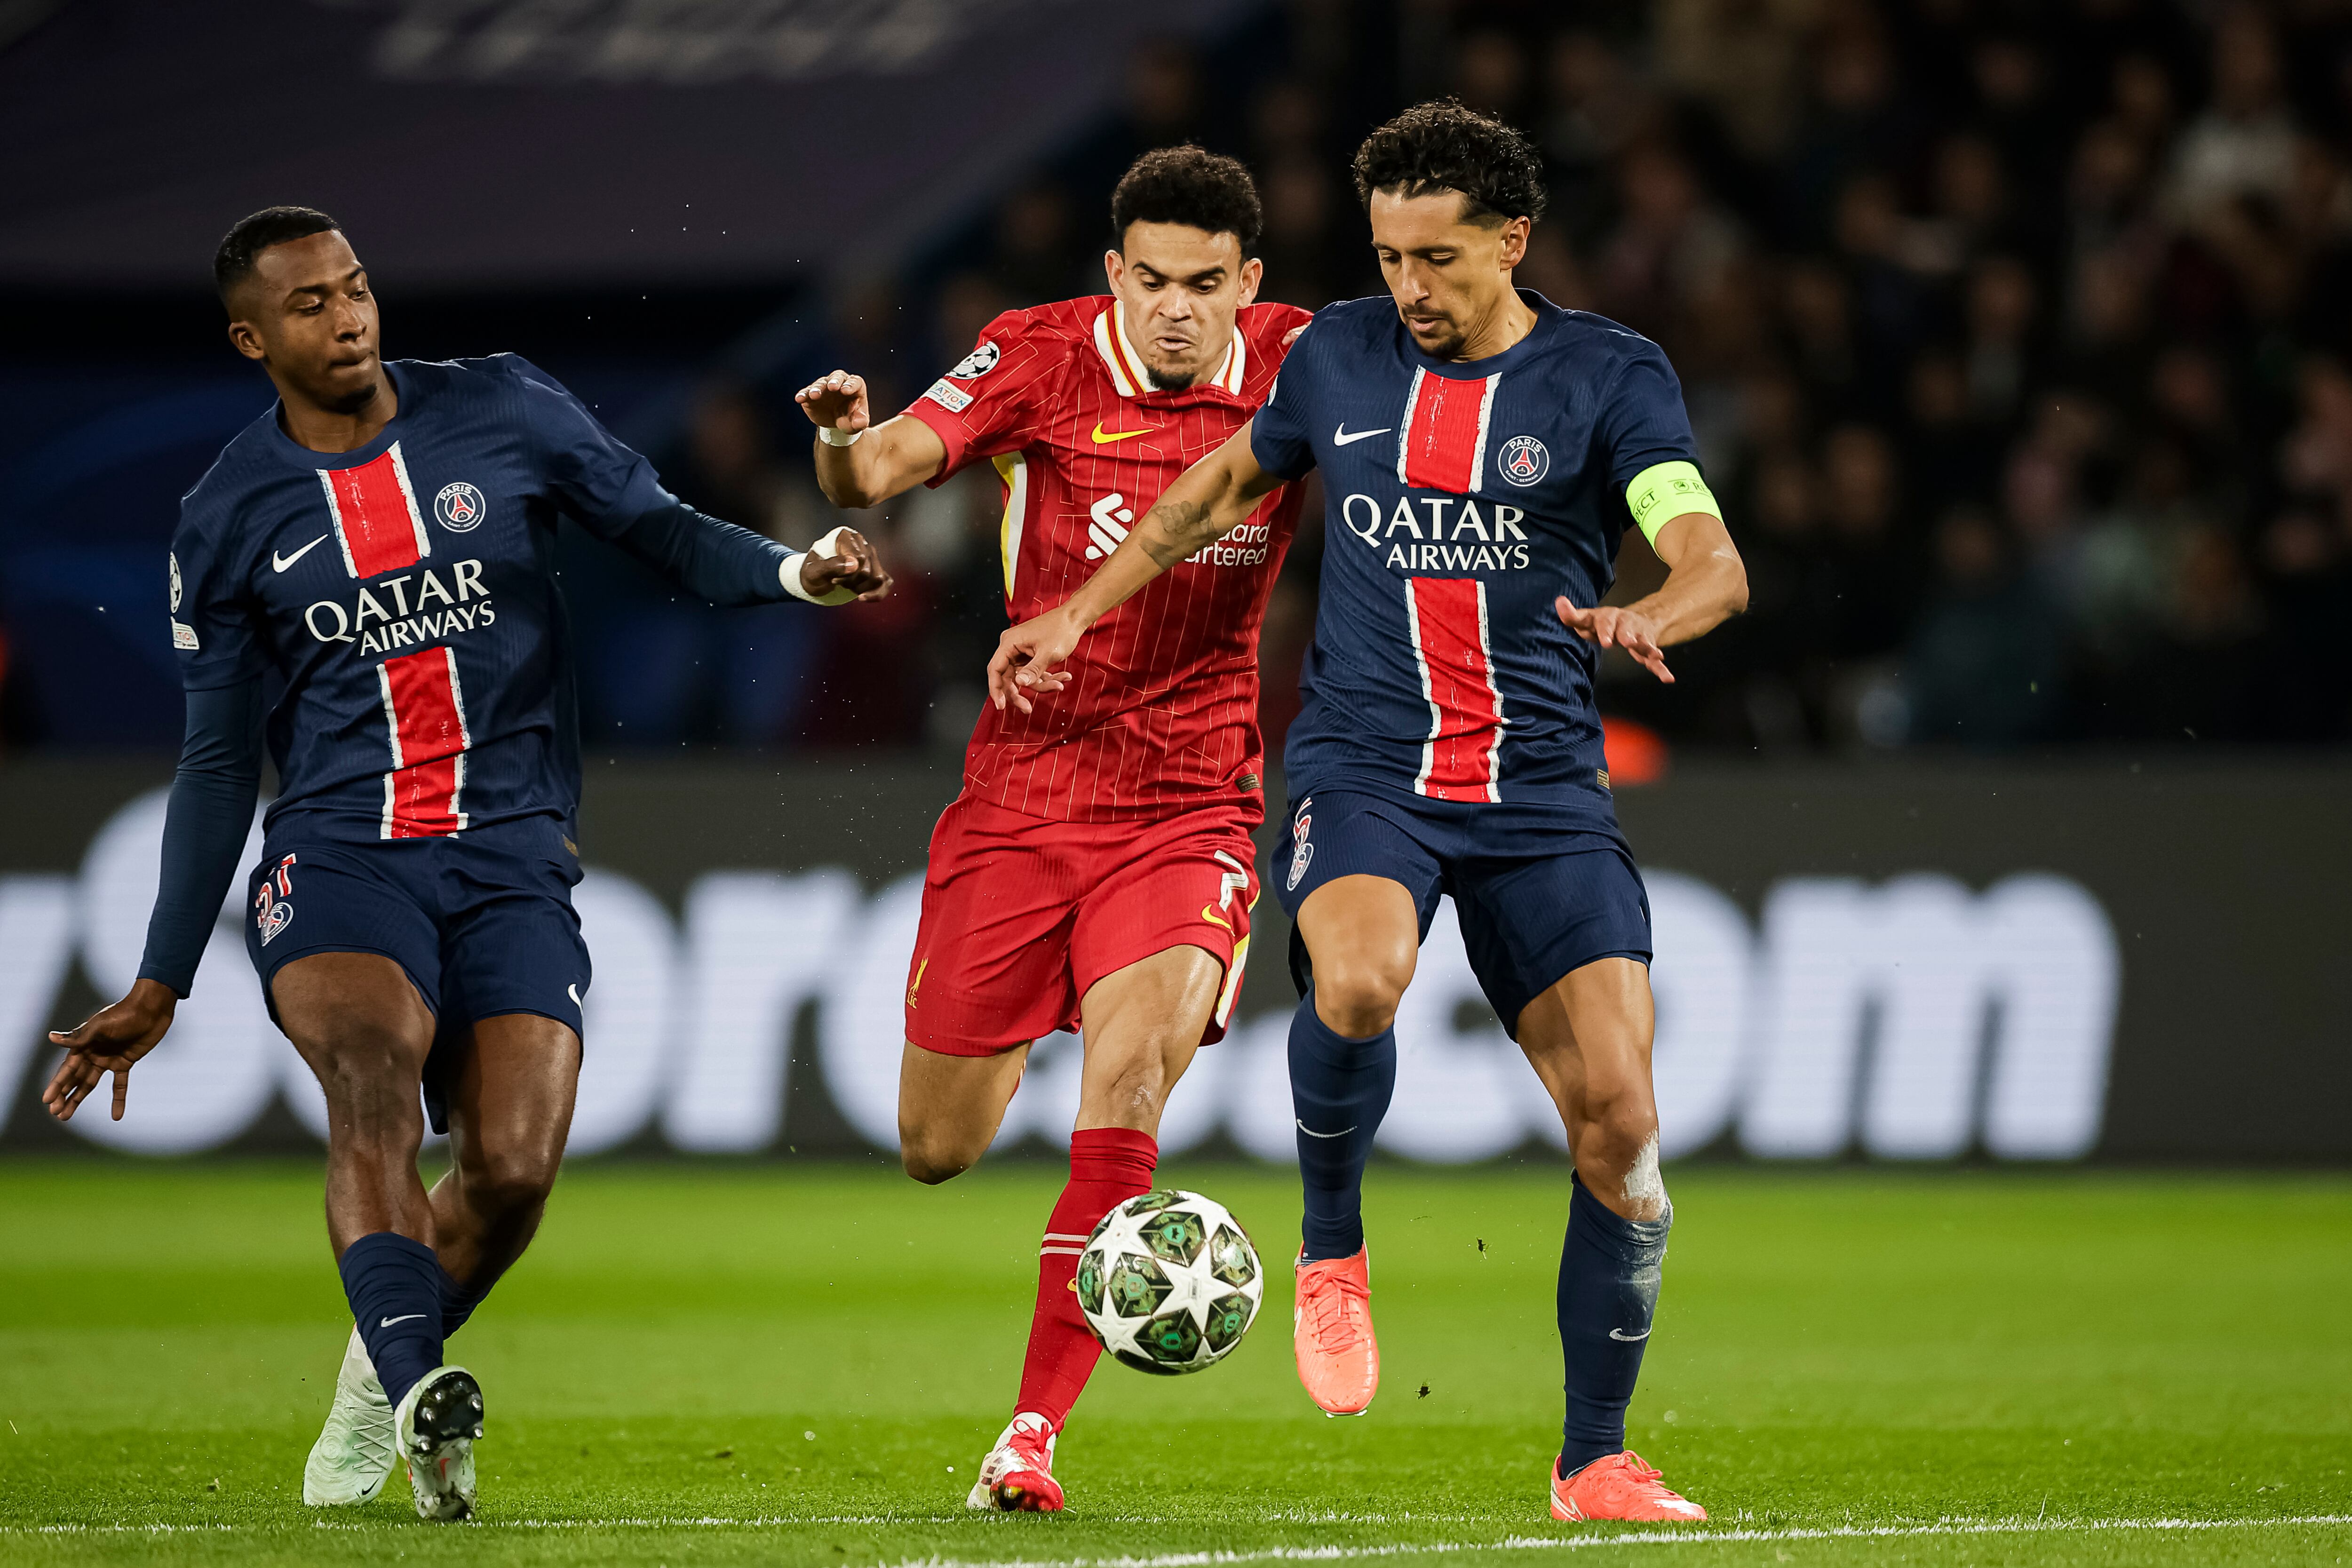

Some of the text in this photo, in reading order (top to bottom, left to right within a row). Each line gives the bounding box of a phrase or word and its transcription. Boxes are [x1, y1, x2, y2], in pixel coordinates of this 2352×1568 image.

[1509, 438, 1542, 452] PARIS
[439, 485, 472, 500] PARIS
[1635, 491, 1655, 524] PECT
[1218, 521, 1271, 543] ard
[1343, 493, 1528, 548] QATAR
[1386, 543, 1530, 571] AIRWAYS
[305, 559, 491, 643] QATAR
[360, 600, 495, 656] AIRWAYS
[1214, 849, 1250, 913] 7
